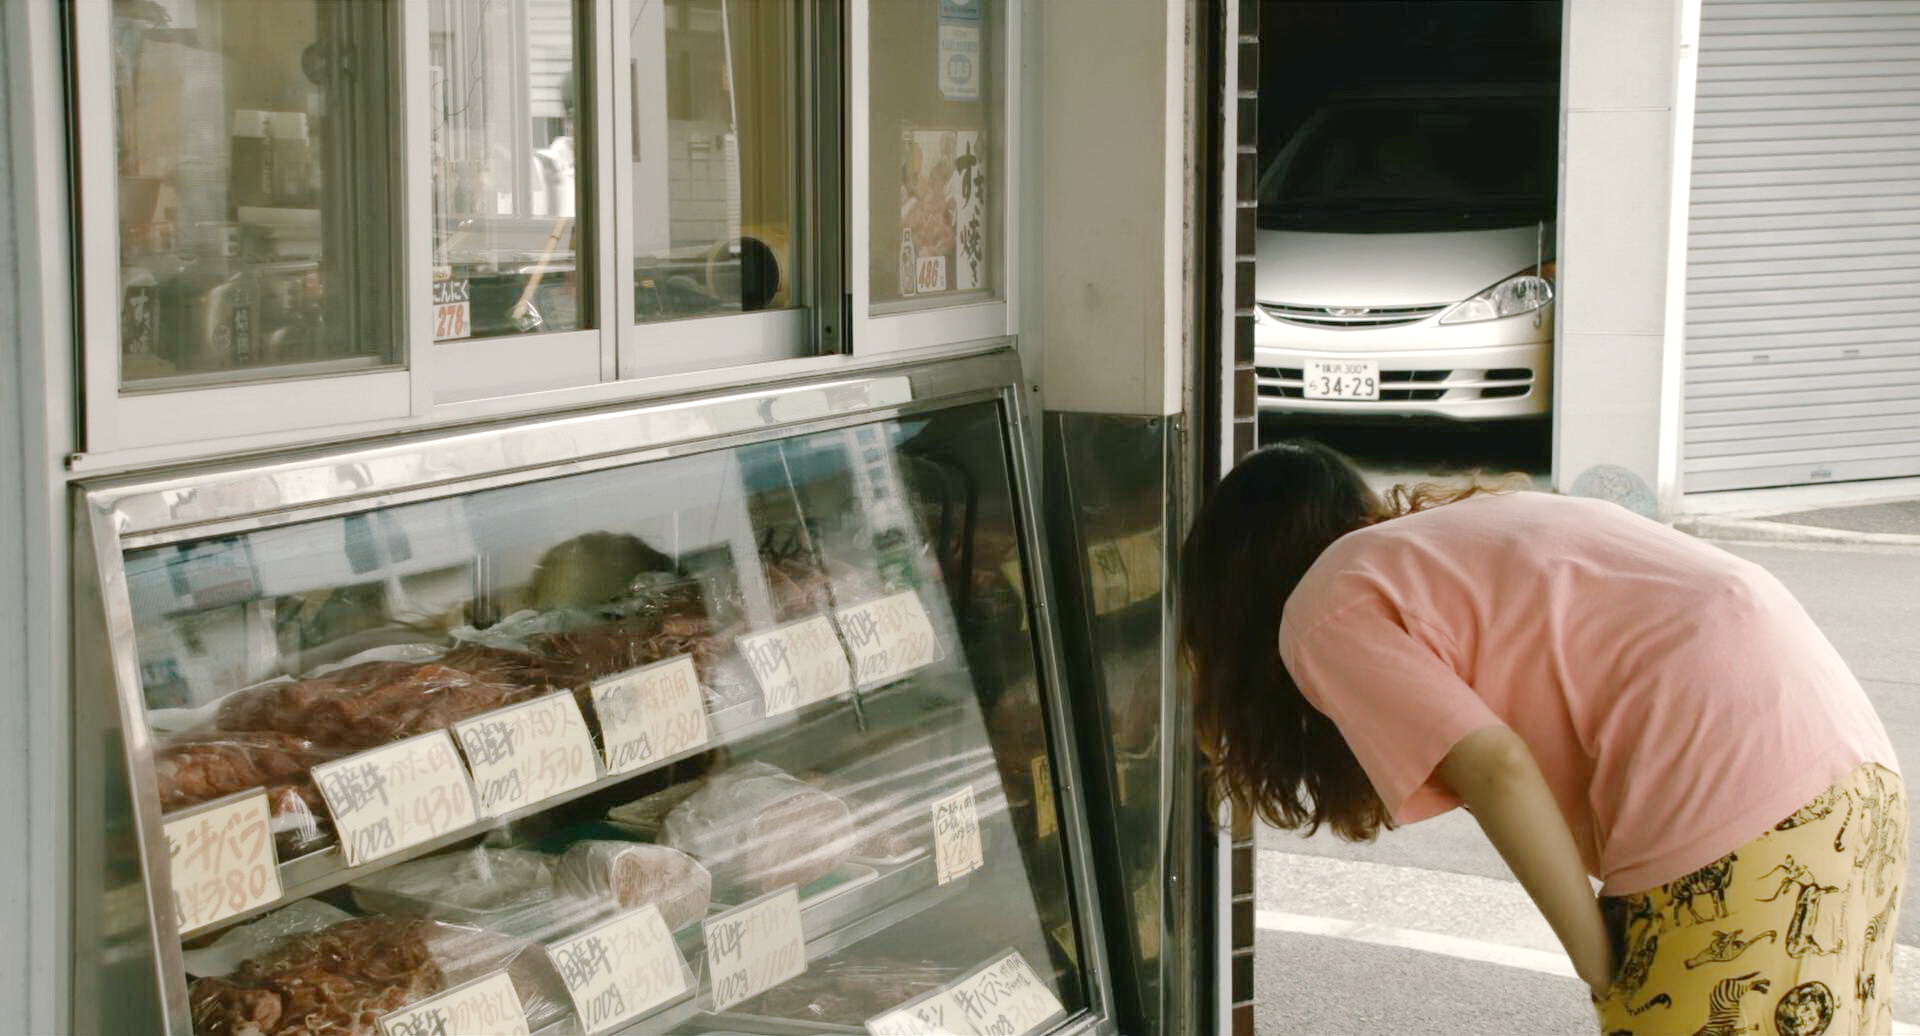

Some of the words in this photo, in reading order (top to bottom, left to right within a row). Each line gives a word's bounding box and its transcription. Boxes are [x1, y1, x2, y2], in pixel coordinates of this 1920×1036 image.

[436, 304, 464, 337] 278
[1320, 376, 1375, 396] 34-29
[1344, 364, 1362, 374] 300
[608, 731, 652, 771] 100g
[482, 768, 522, 808] 100g
[350, 816, 396, 864] 100g
[395, 782, 466, 839] ¥430
[184, 863, 268, 925] ¥380
[716, 968, 749, 1006] 100g
[586, 982, 625, 1033] 100g
